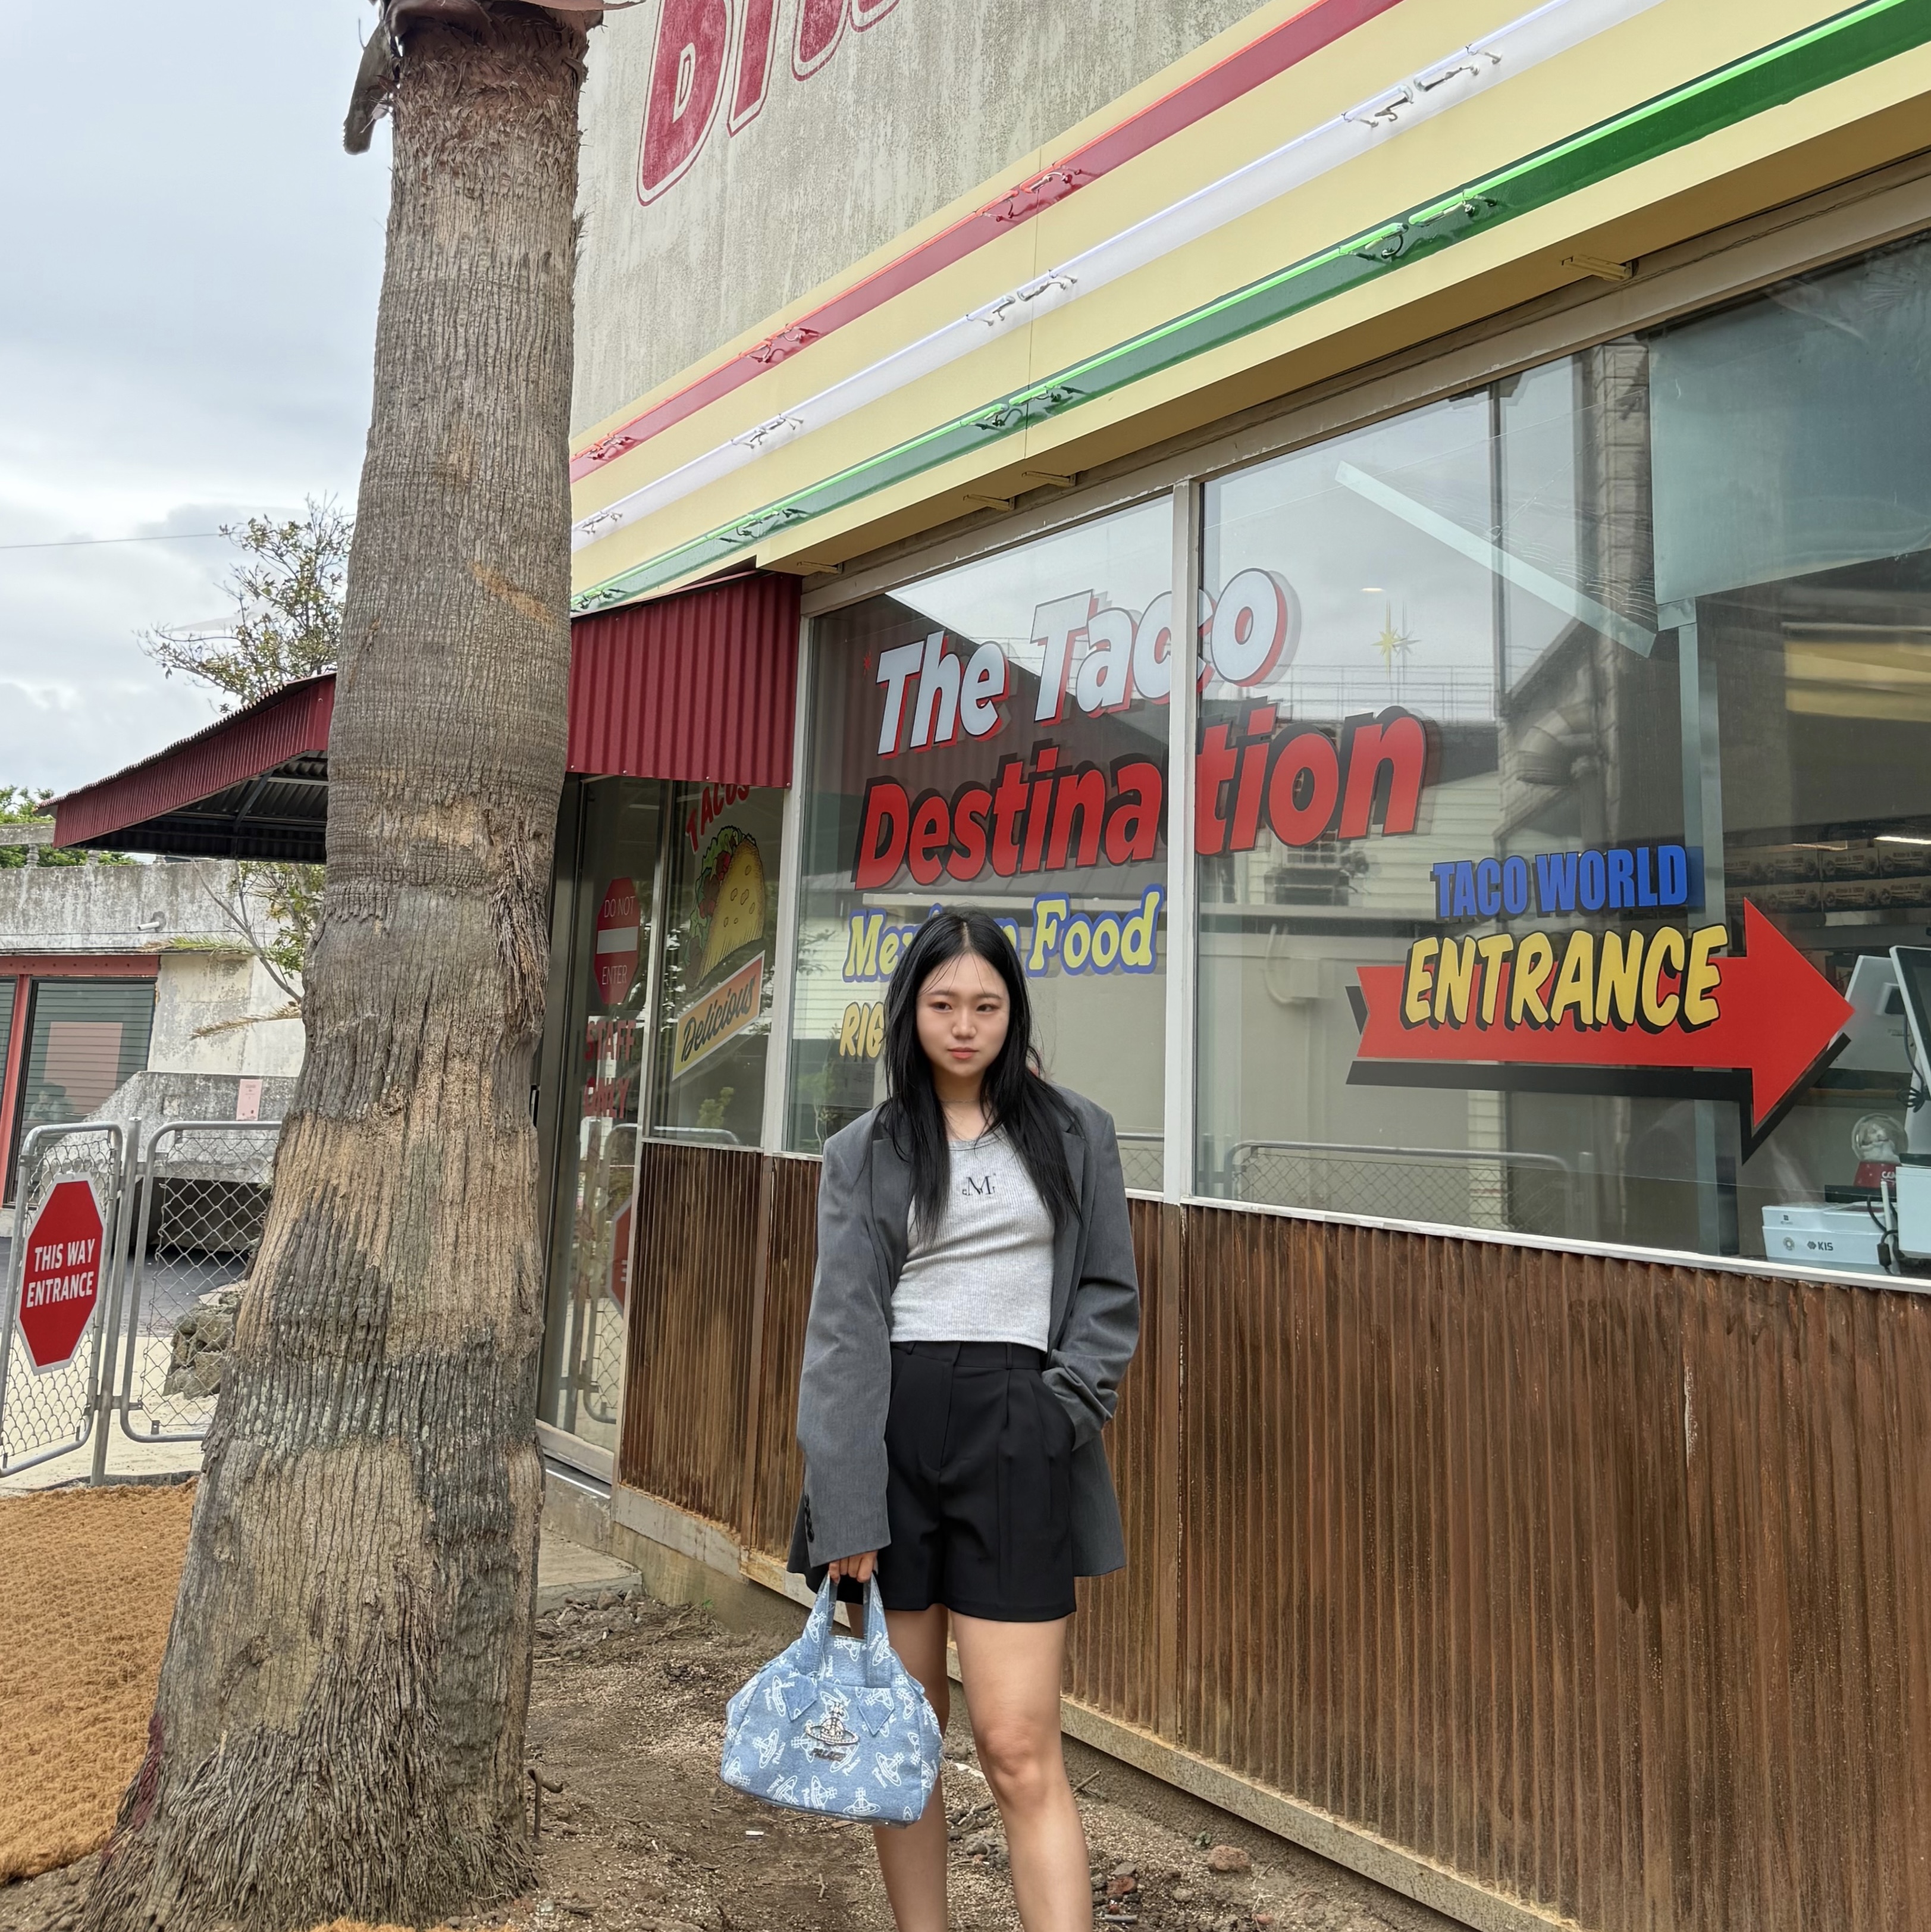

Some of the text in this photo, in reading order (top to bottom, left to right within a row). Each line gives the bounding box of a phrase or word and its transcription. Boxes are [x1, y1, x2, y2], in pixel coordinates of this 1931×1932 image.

[876, 567, 1288, 758] The Taco
[853, 704, 1425, 890] Destination
[1433, 844, 1689, 919] TACO WORLD
[604, 896, 635, 918] DO NOT
[1026, 884, 1164, 977] Food
[602, 965, 628, 985] ENTER
[1403, 925, 1729, 1032] ENTRANCE
[681, 974, 756, 1062] Delicious
[585, 1019, 637, 1061] STAFF
[584, 1077, 631, 1119] ONLY
[35, 1238, 95, 1272] THIS WAY
[1817, 1241, 1833, 1251] KIS
[26, 1271, 95, 1308] ENTRANCE
